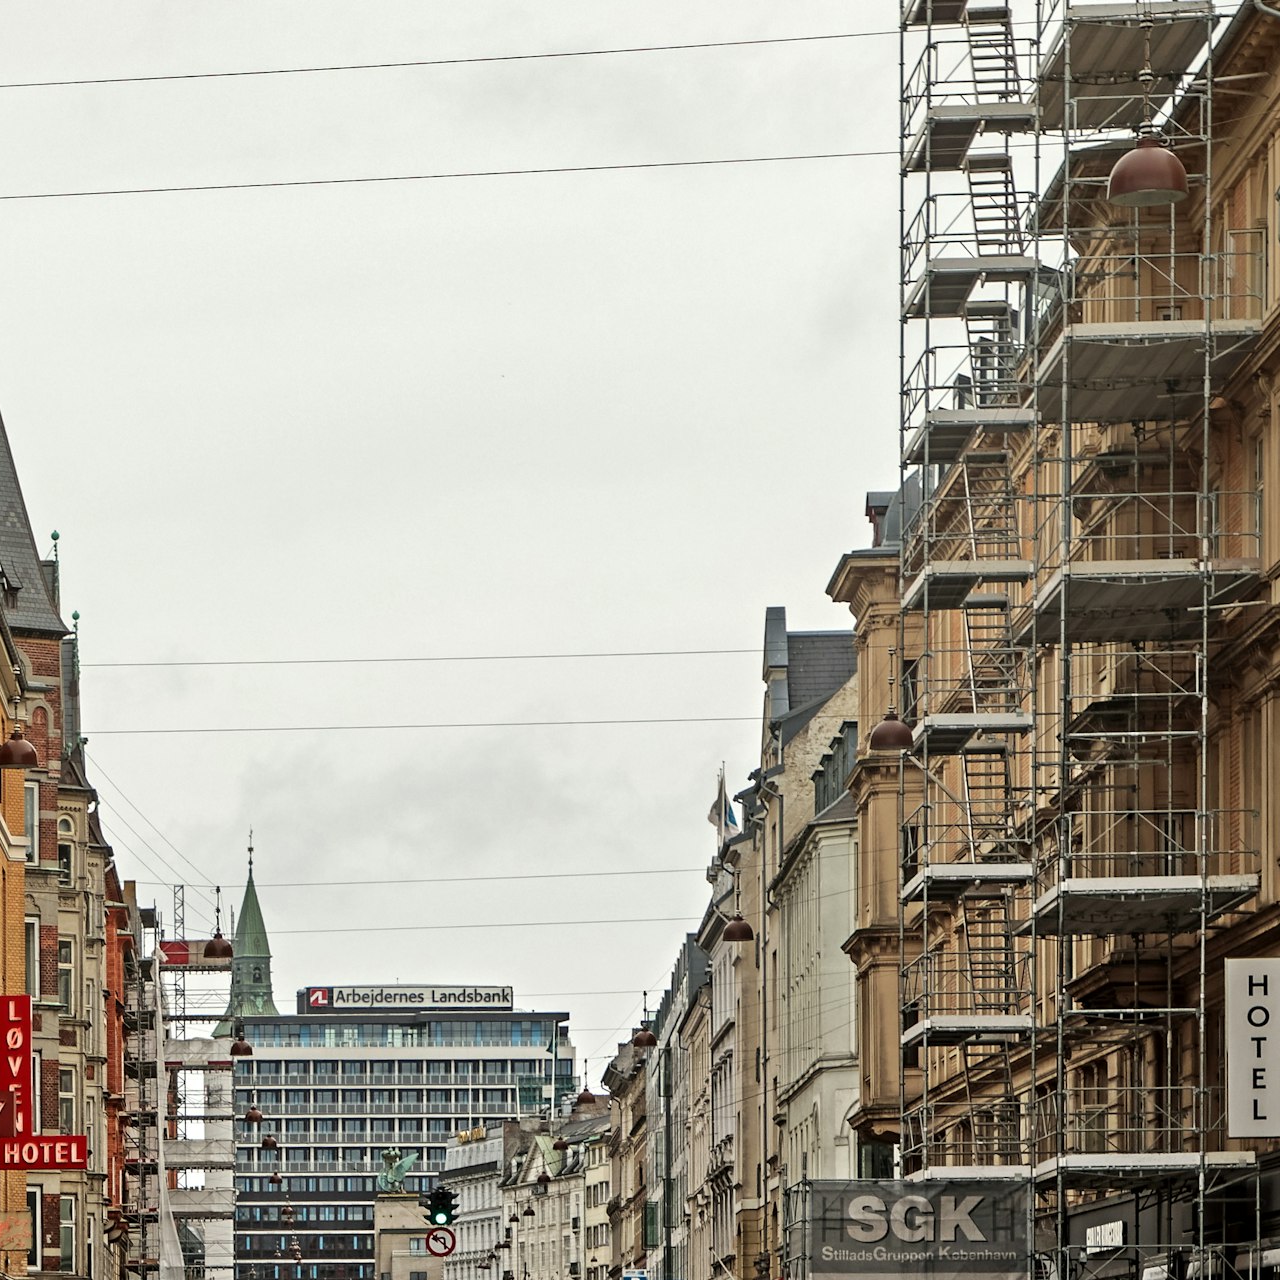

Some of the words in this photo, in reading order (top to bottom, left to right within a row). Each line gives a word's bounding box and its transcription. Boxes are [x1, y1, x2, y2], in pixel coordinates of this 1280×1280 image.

[335, 989, 424, 1007] Arbejdernes
[431, 988, 510, 1004] Landsbank
[1247, 974, 1270, 1121] HOTEL
[4, 1142, 85, 1165] HOTEL
[846, 1194, 987, 1243] SGK
[821, 1246, 934, 1264] StilladsGruppen
